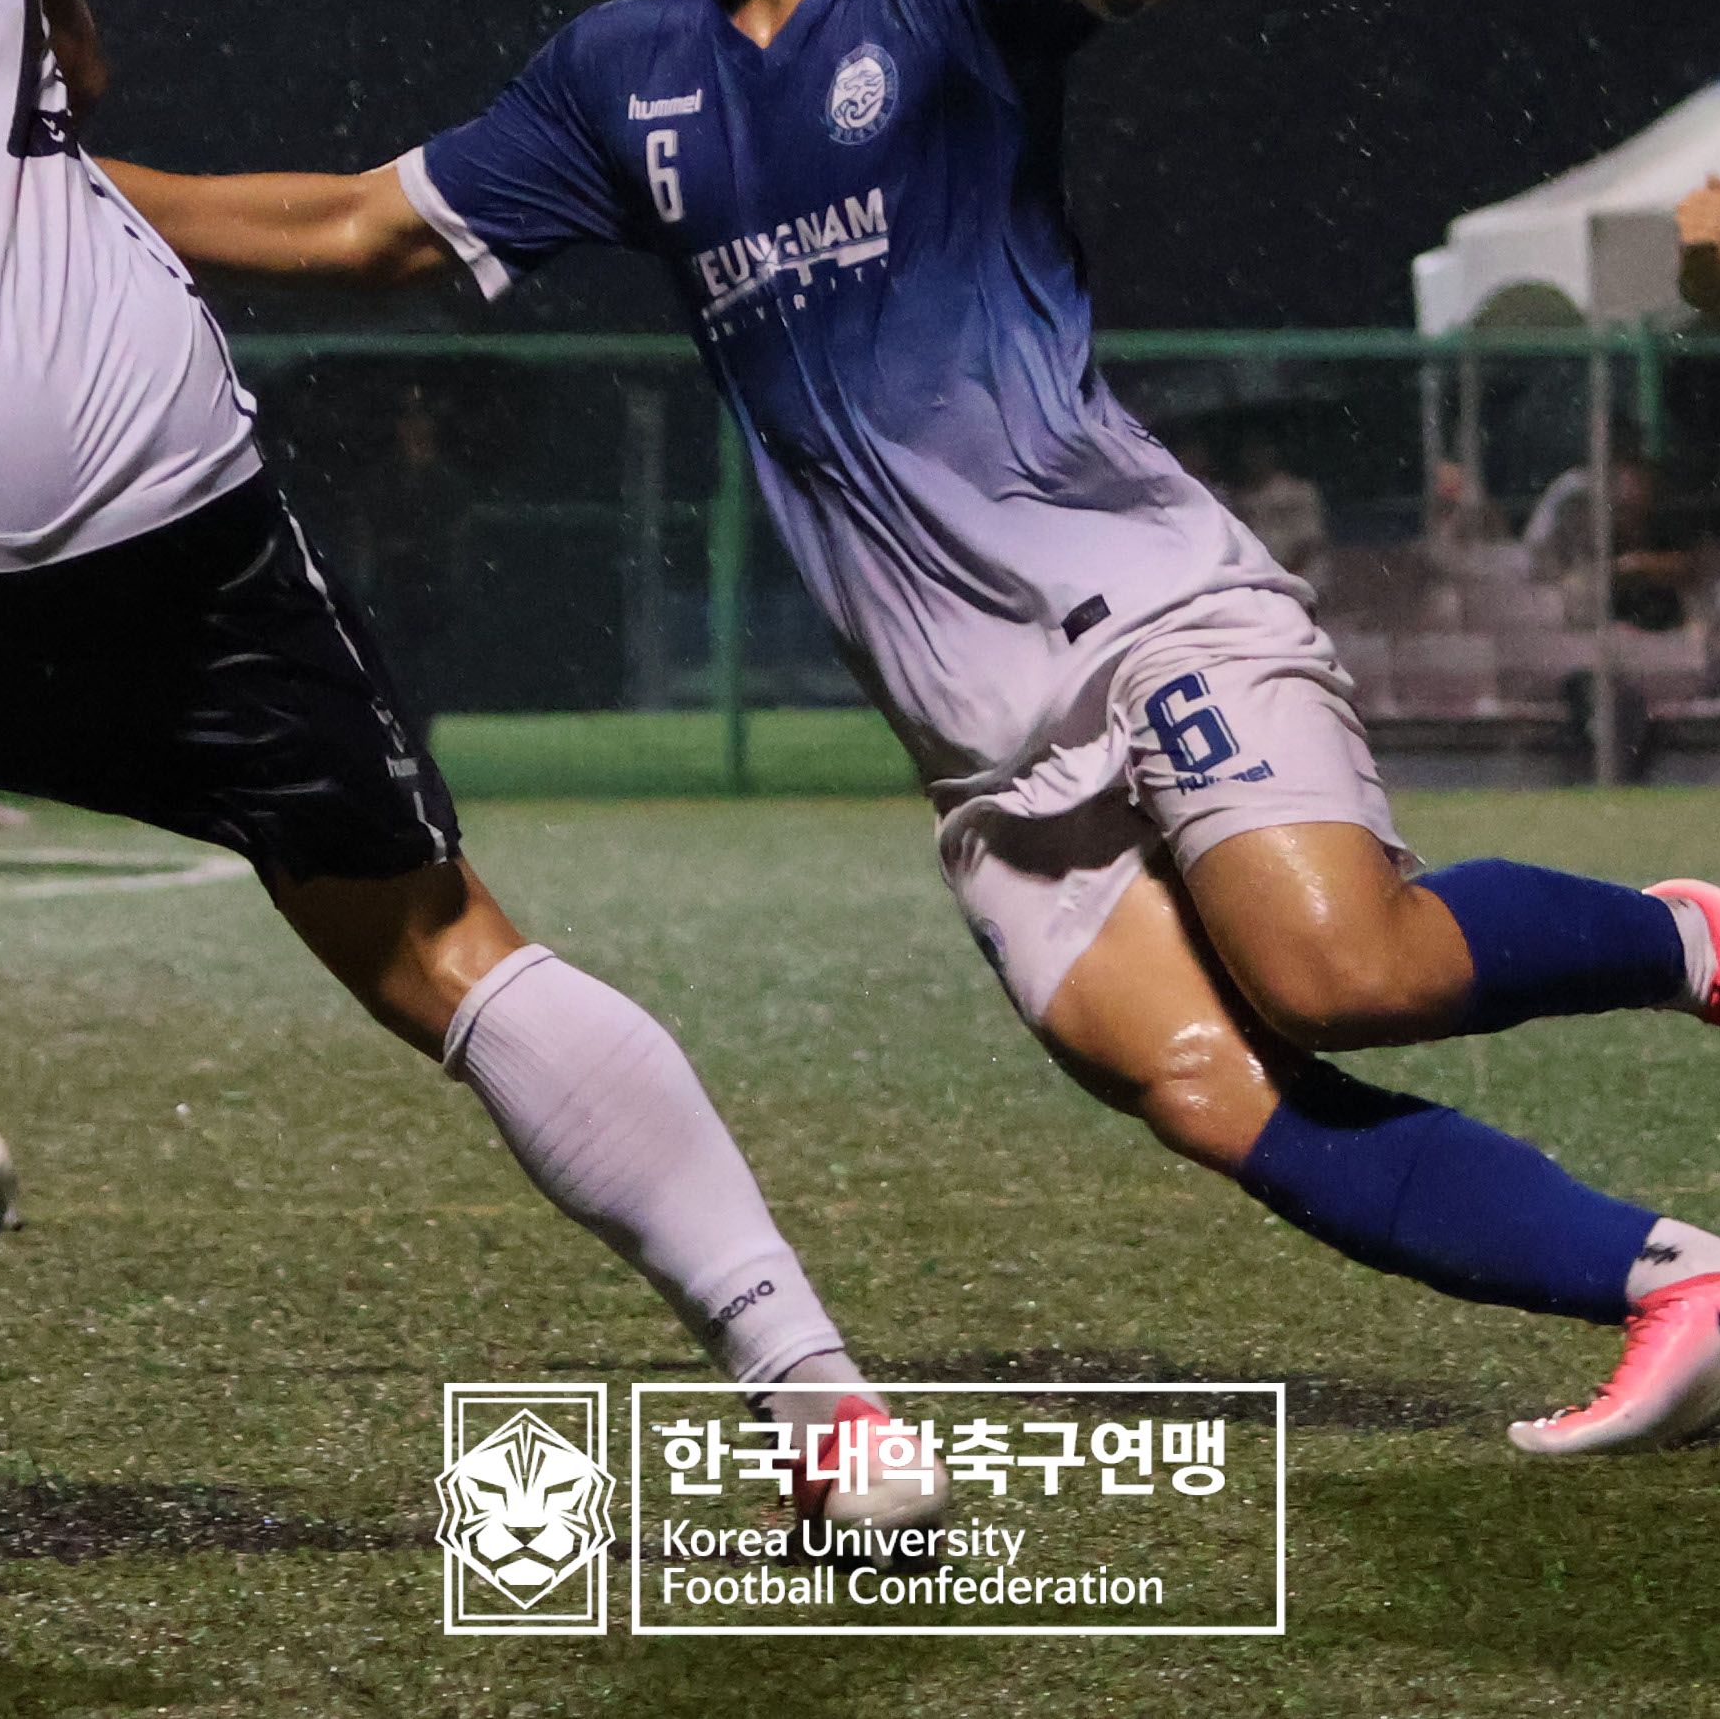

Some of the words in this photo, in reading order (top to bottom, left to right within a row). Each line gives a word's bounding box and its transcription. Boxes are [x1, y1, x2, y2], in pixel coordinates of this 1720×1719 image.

[628, 88, 703, 121] hummel
[645, 128, 685, 223] 6
[1143, 670, 1241, 775] 6
